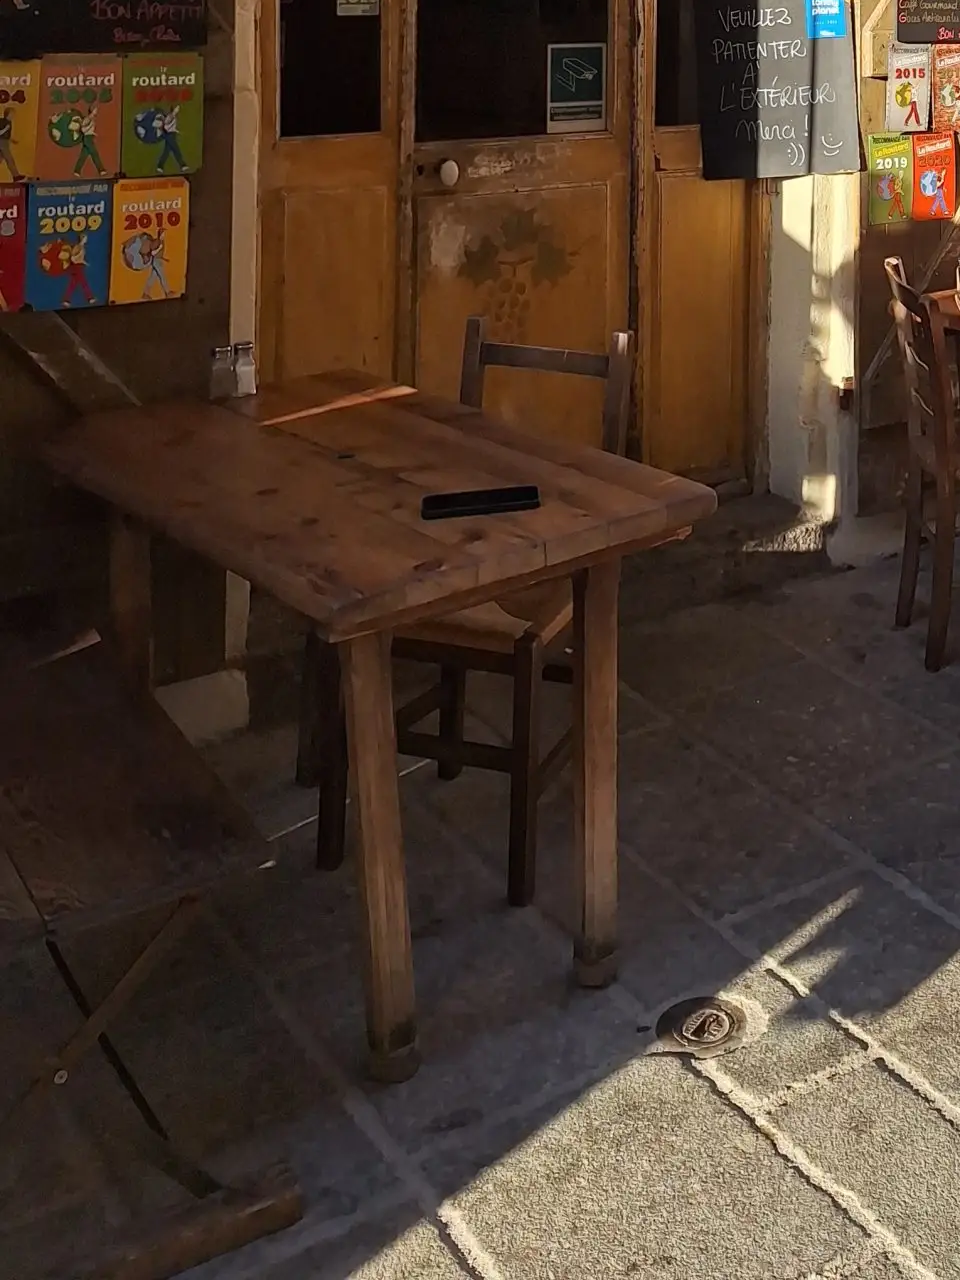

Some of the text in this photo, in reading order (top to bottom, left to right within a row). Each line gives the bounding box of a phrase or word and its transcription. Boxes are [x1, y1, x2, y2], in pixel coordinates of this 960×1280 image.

[718, 5, 792, 33] VEUILLEZ
[937, 26, 956, 40] BON
[712, 38, 807, 65] PATIENTER
[46, 72, 115, 87] routard
[131, 72, 195, 87] routard
[895, 67, 926, 80] 2015
[719, 76, 836, 112] L'EXTÉRIEUR
[876, 157, 908, 170] 2019
[37, 201, 105, 216] routard
[123, 198, 182, 212] routard
[39, 215, 102, 234] 2009
[124, 211, 181, 231] 2010
